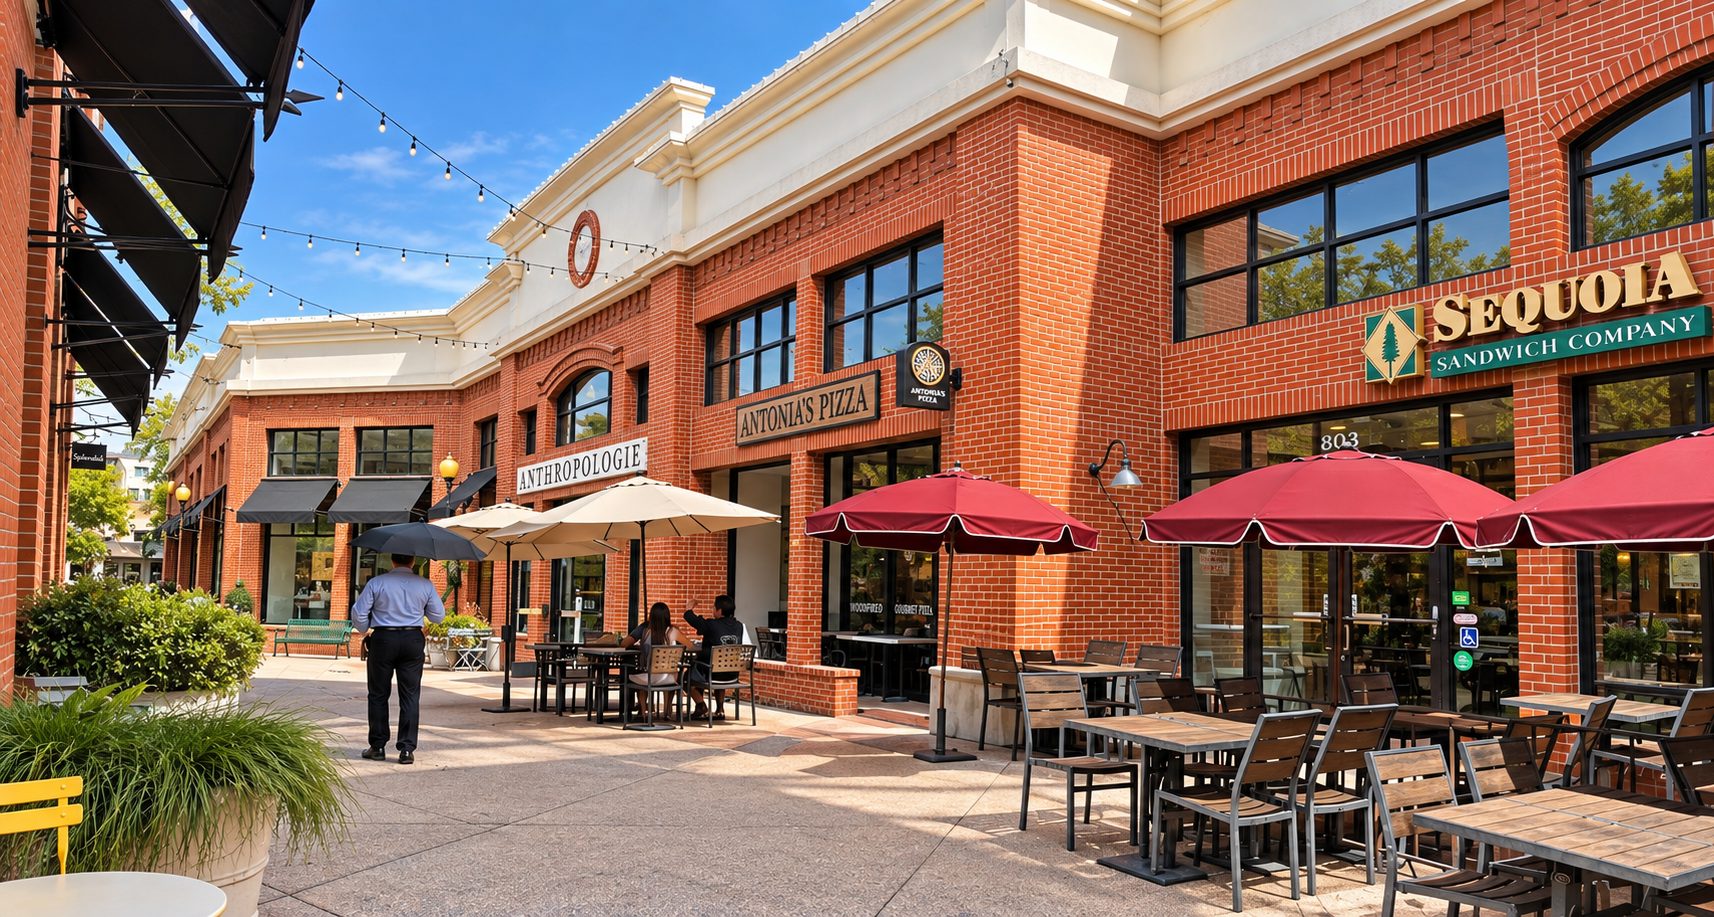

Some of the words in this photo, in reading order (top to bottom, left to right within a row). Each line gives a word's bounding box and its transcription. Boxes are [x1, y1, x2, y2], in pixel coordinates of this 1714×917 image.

[1432, 250, 1705, 343] SEQUOIA
[1436, 338, 1557, 372] SANDWICH
[1568, 314, 1696, 350] COMPANY
[740, 396, 814, 438] ANTONIA'S
[818, 383, 869, 421] PIZZA
[519, 443, 641, 490] ANTHROPOLOGIE
[1320, 431, 1359, 451] 803
